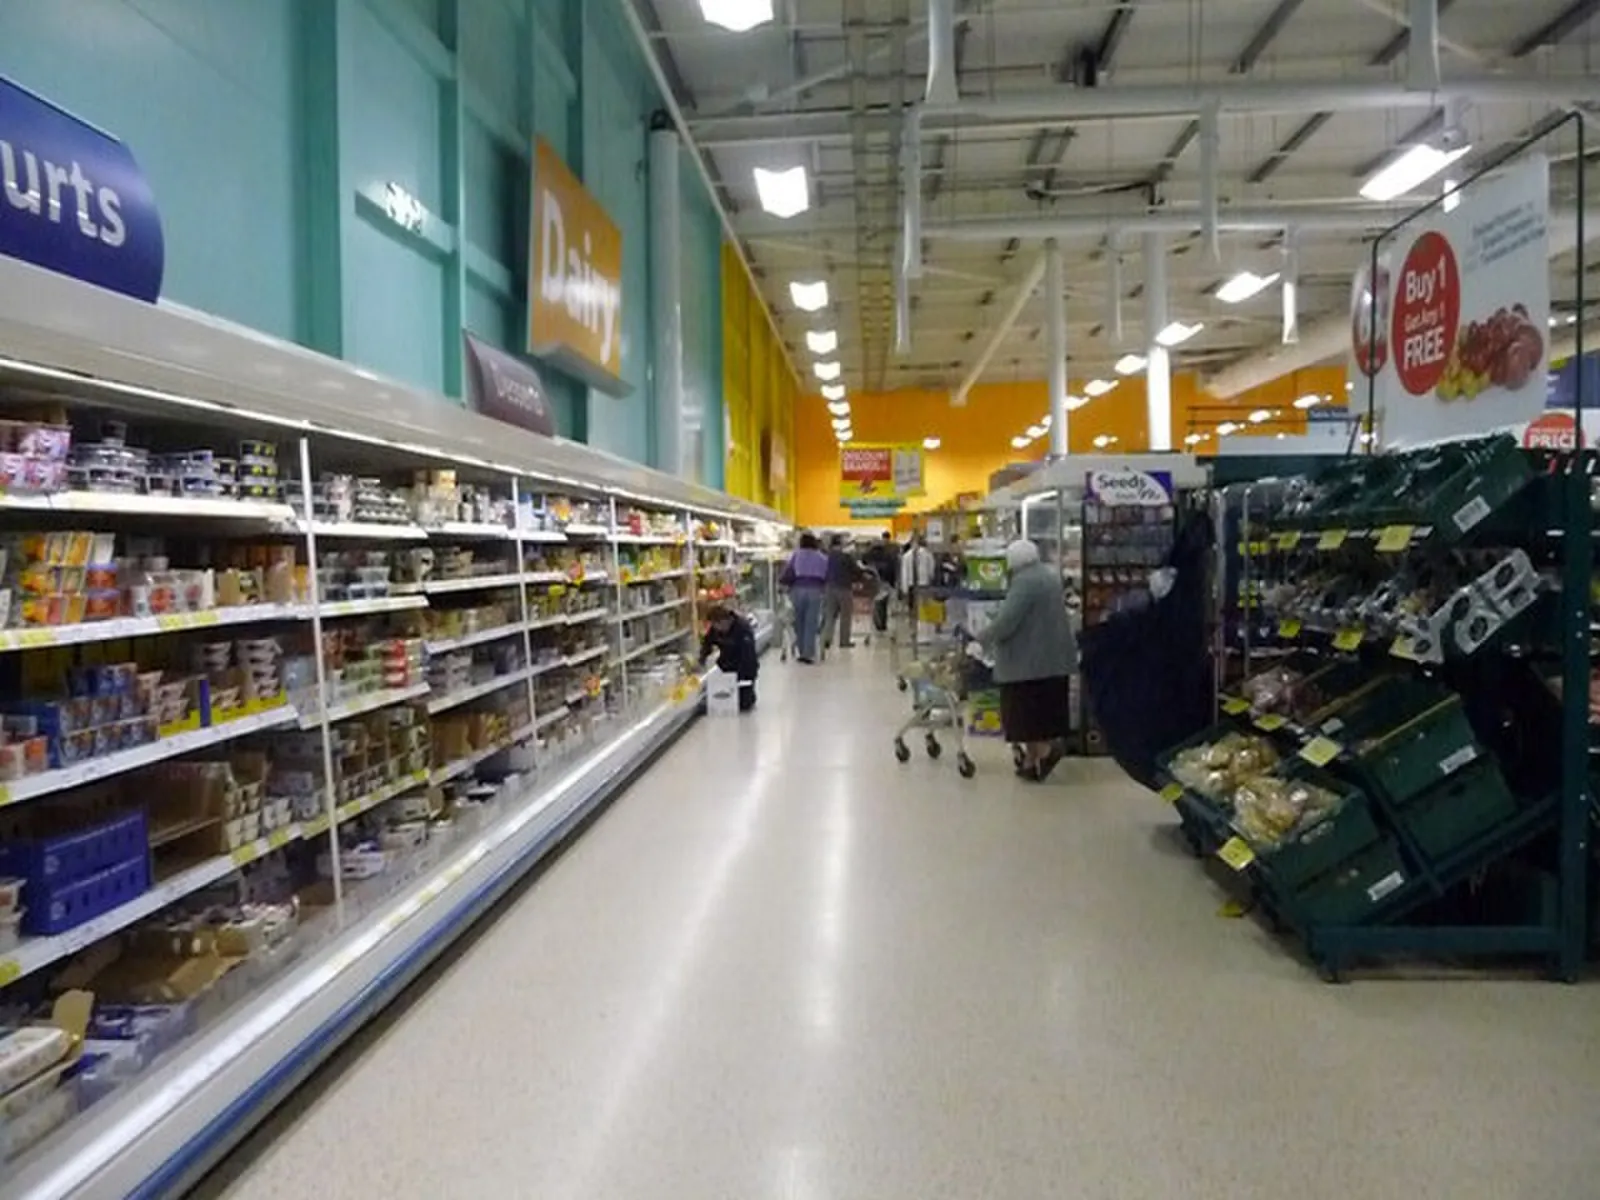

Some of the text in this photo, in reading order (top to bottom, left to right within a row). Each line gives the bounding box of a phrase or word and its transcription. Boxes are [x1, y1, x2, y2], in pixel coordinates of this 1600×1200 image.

[541, 188, 618, 365] Dairy
[1405, 269, 1437, 305] Buy
[1437, 254, 1446, 289] 1
[1404, 326, 1446, 370] FREE
[1098, 474, 1148, 490] Seeds
